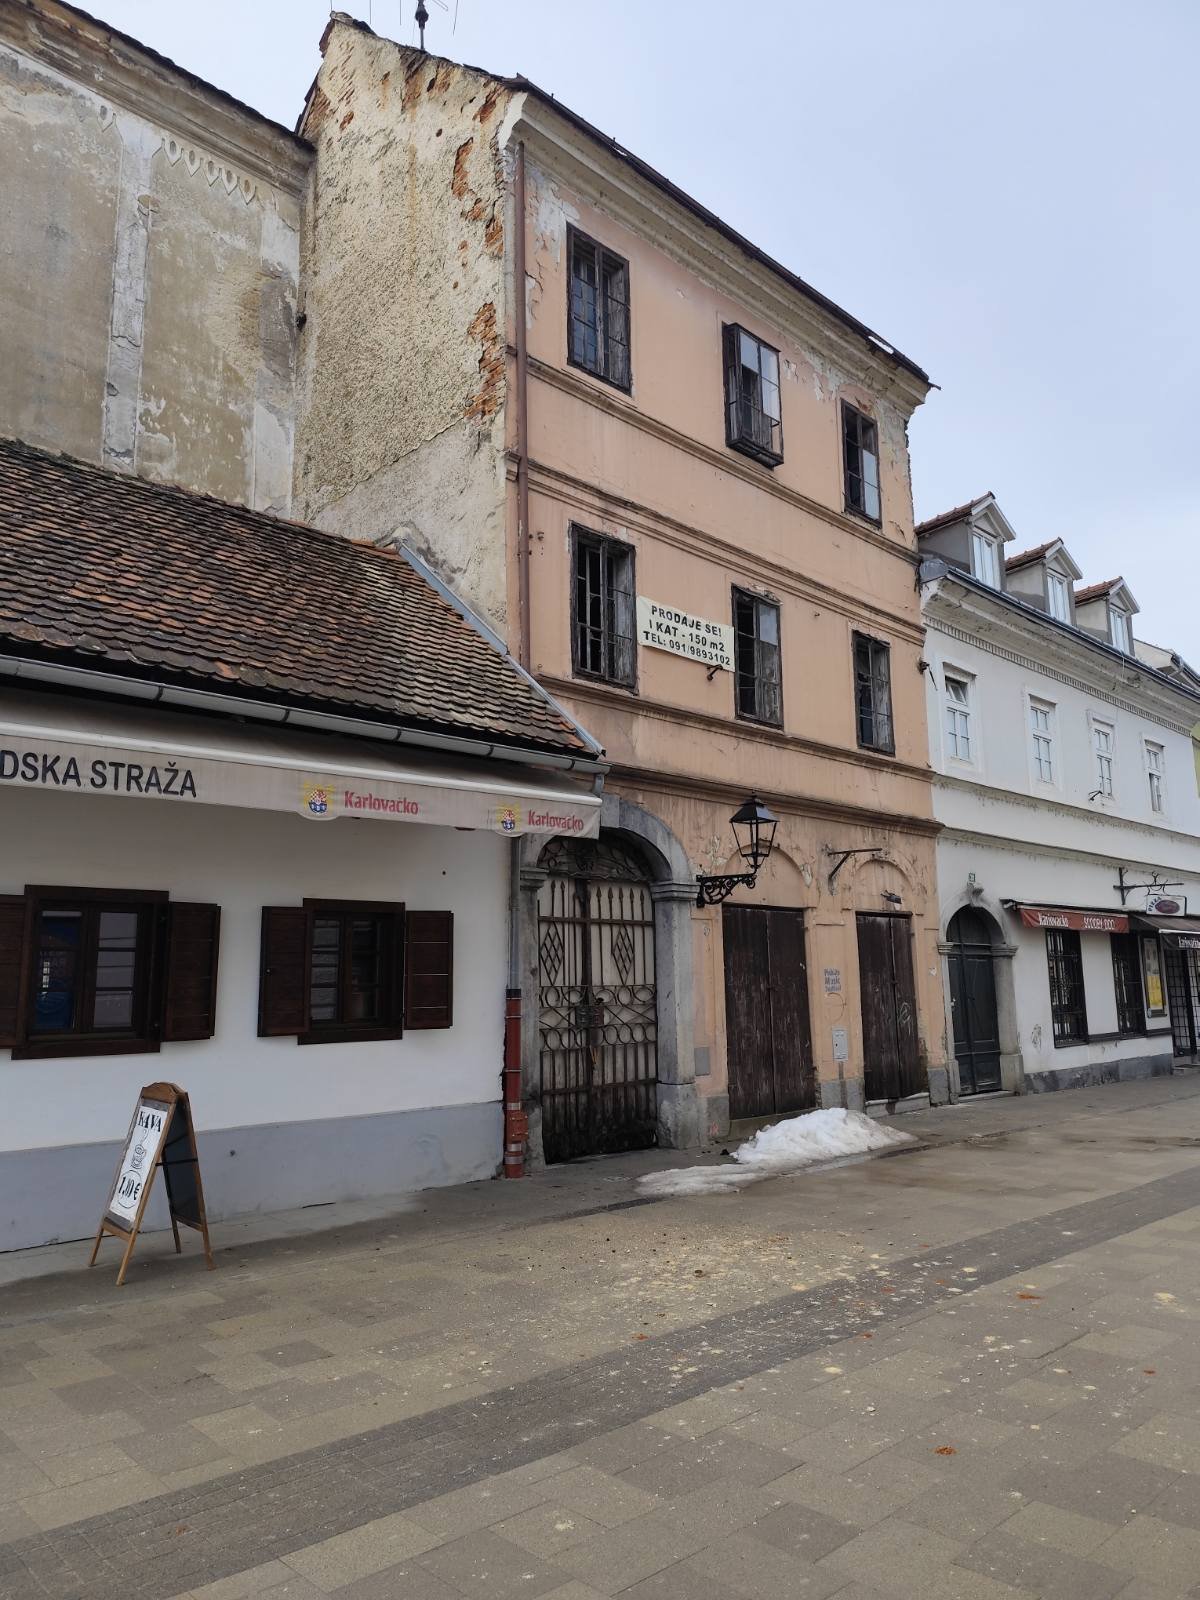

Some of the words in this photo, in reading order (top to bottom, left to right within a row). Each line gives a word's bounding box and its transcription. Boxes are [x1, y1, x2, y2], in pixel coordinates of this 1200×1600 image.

[651, 605, 702, 631] PRODAJE
[705, 624, 722, 637] SE!
[656, 621, 678, 638] KAT
[689, 632, 707, 647] 150
[710, 641, 725, 653] m2
[643, 631, 666, 646] TEL:
[669, 640, 730, 666] 091/9893102
[0, 750, 82, 787] DSKA
[90, 760, 197, 798] STRAŽA
[344, 790, 419, 815] Karlovačko
[528, 809, 584, 832] Karlovačko
[138, 1111, 162, 1132] KAVA
